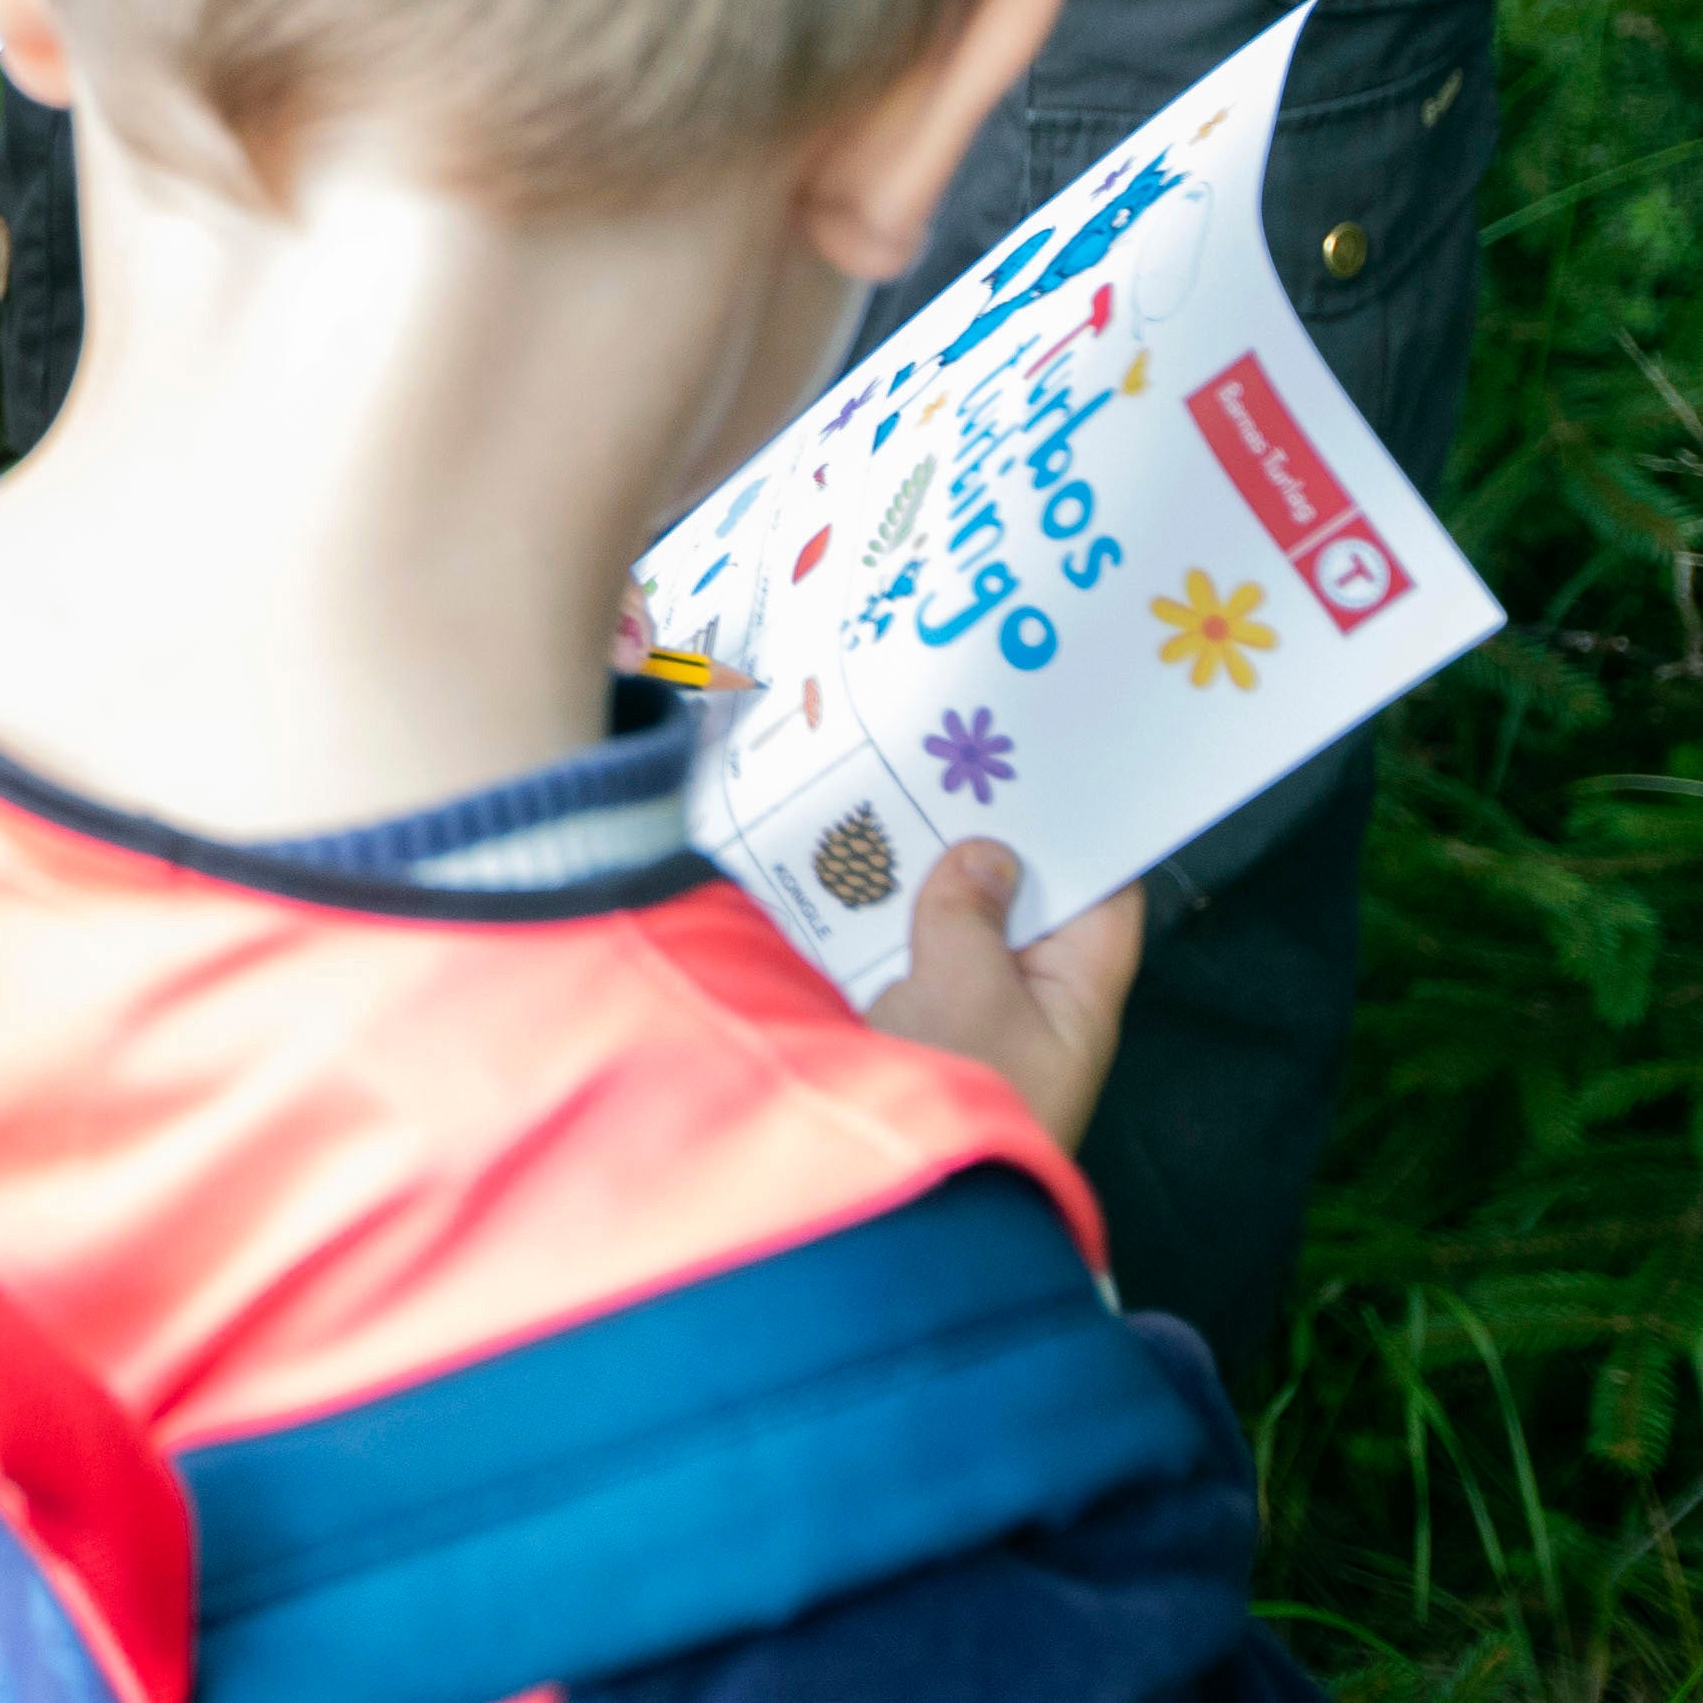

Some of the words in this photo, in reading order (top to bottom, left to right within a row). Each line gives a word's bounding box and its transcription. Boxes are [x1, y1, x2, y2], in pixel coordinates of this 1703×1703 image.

[1024, 284, 1122, 591] Turbos
[1335, 552, 1375, 589] T
[774, 863, 831, 940] KONGLE
